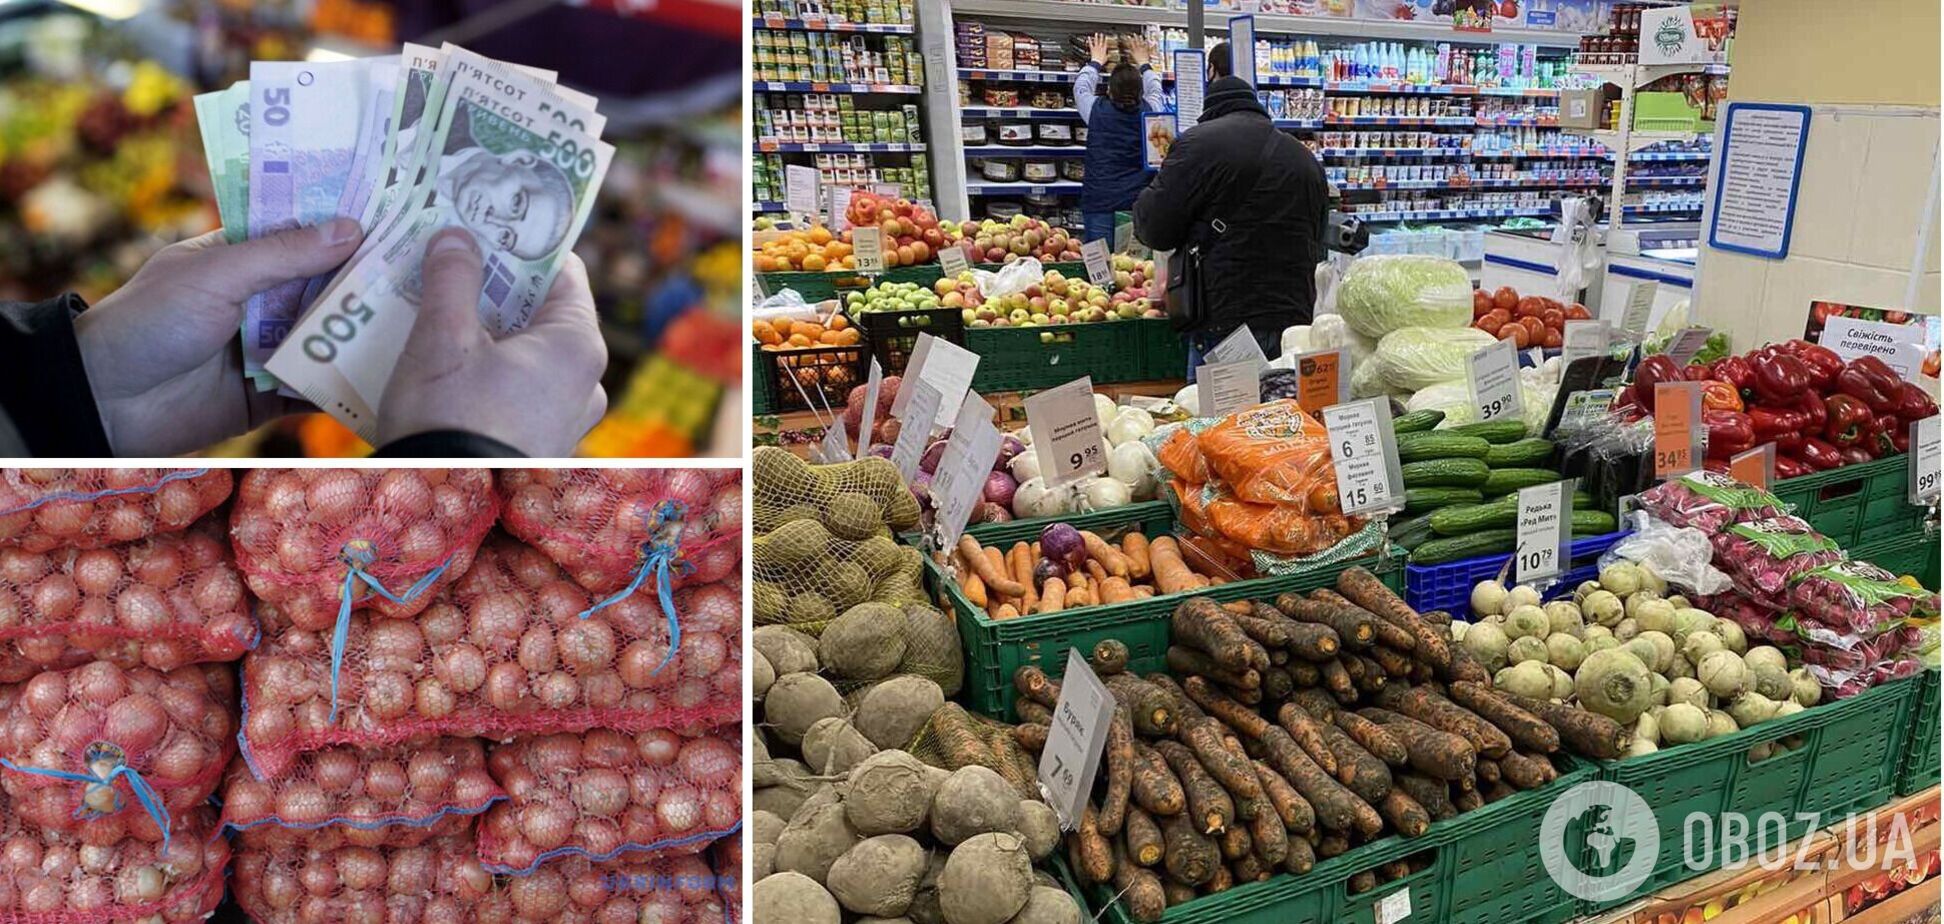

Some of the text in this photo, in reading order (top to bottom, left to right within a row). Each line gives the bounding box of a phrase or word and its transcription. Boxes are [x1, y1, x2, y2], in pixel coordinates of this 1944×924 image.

[457, 61, 527, 101] П'ЯТСОТ
[263, 87, 291, 127] 50
[463, 86, 535, 128] П'ЯТСОТ
[539, 130, 596, 178] 500
[302, 292, 376, 363] 500
[1847, 328, 1894, 343] Свіжість
[1840, 340, 1896, 355] перевірено
[1342, 440, 1353, 458] 6
[1070, 453, 1083, 470] 9
[1919, 473, 1934, 491] 99
[1346, 488, 1367, 508] 15
[1373, 482, 1384, 493] 60
[1525, 503, 1552, 515] Редька
[1520, 552, 1540, 572] 10
[1051, 754, 1063, 778] 7
